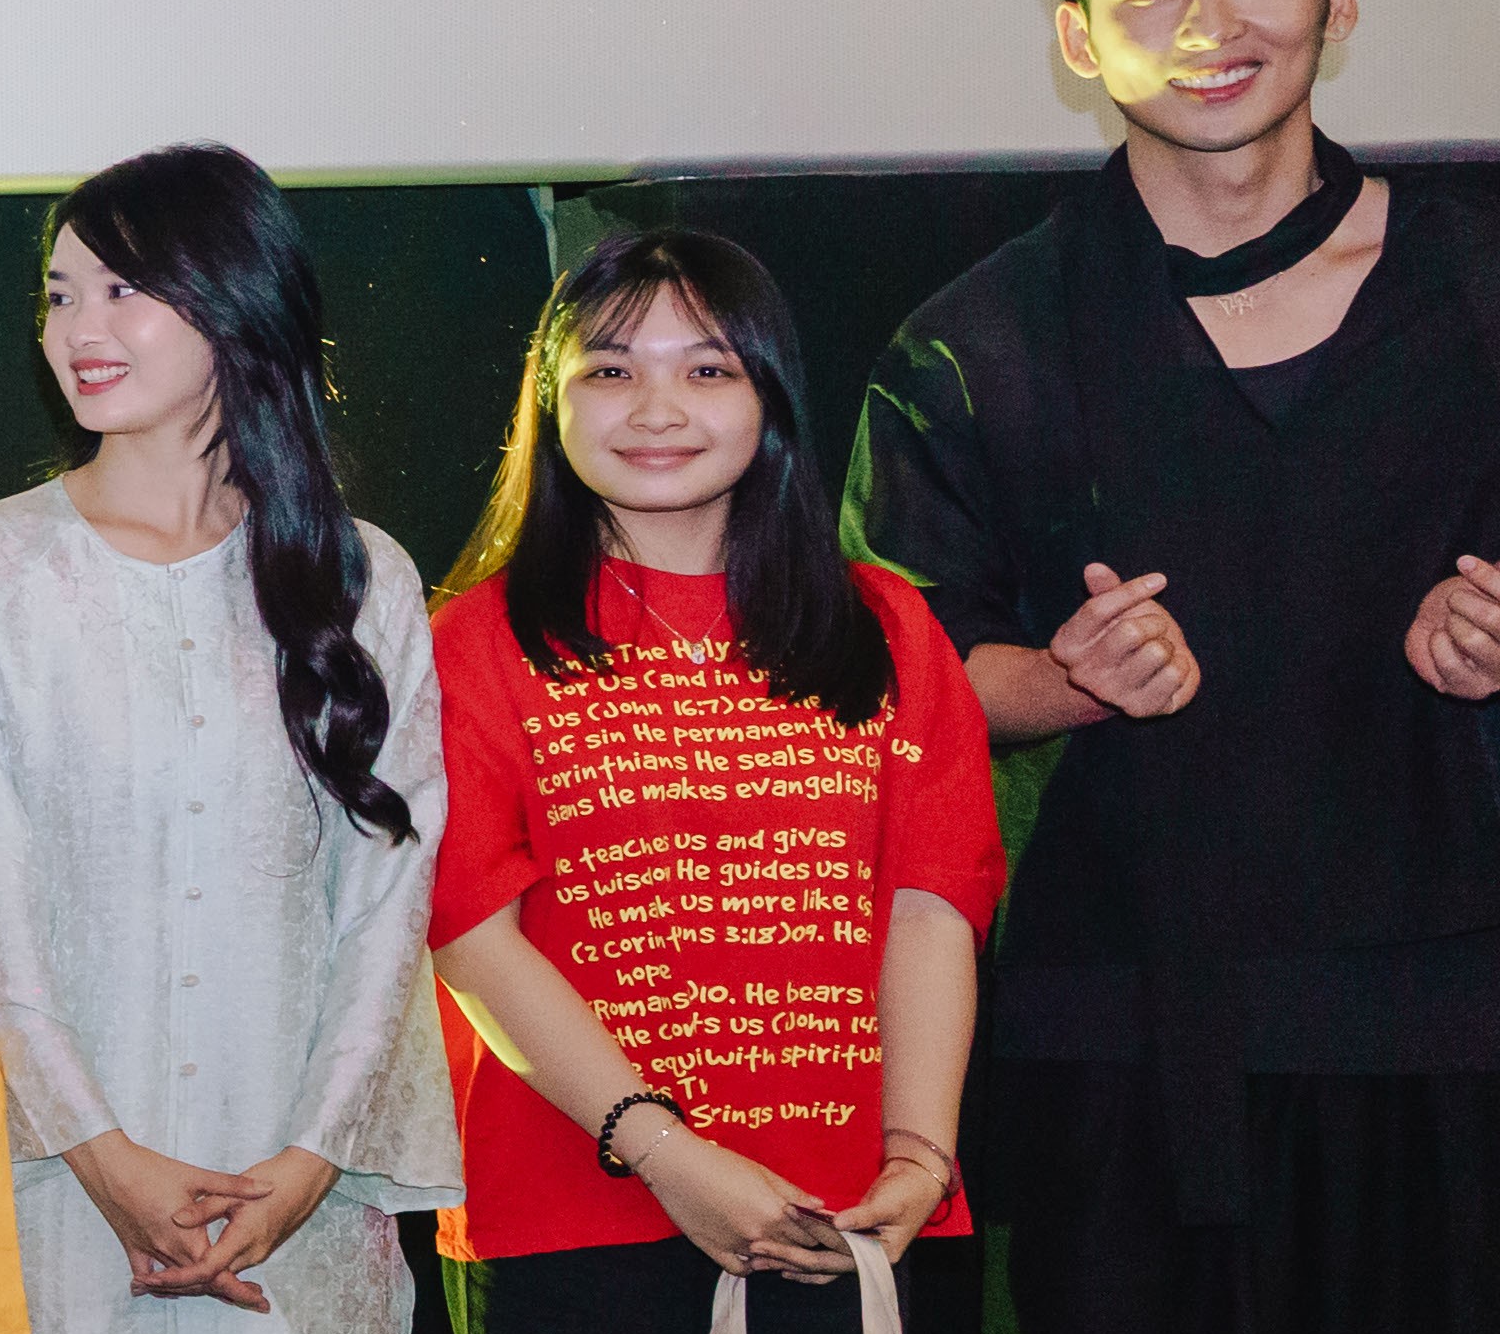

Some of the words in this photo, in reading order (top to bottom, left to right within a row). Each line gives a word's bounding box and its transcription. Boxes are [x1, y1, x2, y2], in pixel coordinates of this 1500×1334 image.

[617, 643, 668, 663] The
[672, 637, 730, 661] Hly
[644, 670, 707, 688] (and
[714, 670, 739, 686] in
[587, 701, 663, 721] (John
[585, 729, 626, 749] sin
[633, 723, 667, 743] He
[674, 715, 847, 747] permanently
[694, 750, 730, 773] He
[737, 744, 816, 770] seals
[599, 785, 636, 808] He
[642, 776, 728, 802] makes
[735, 771, 878, 803] evangelists
[716, 829, 765, 852] and
[773, 827, 847, 854] gives
[676, 858, 711, 881] He
[719, 859, 811, 887] guides
[588, 906, 615, 929] He
[721, 895, 796, 915] more
[802, 887, 849, 911] like
[616, 964, 673, 987] hope
[745, 982, 780, 1006] He
[786, 981, 864, 1005] bears
[771, 1011, 841, 1035] (John
